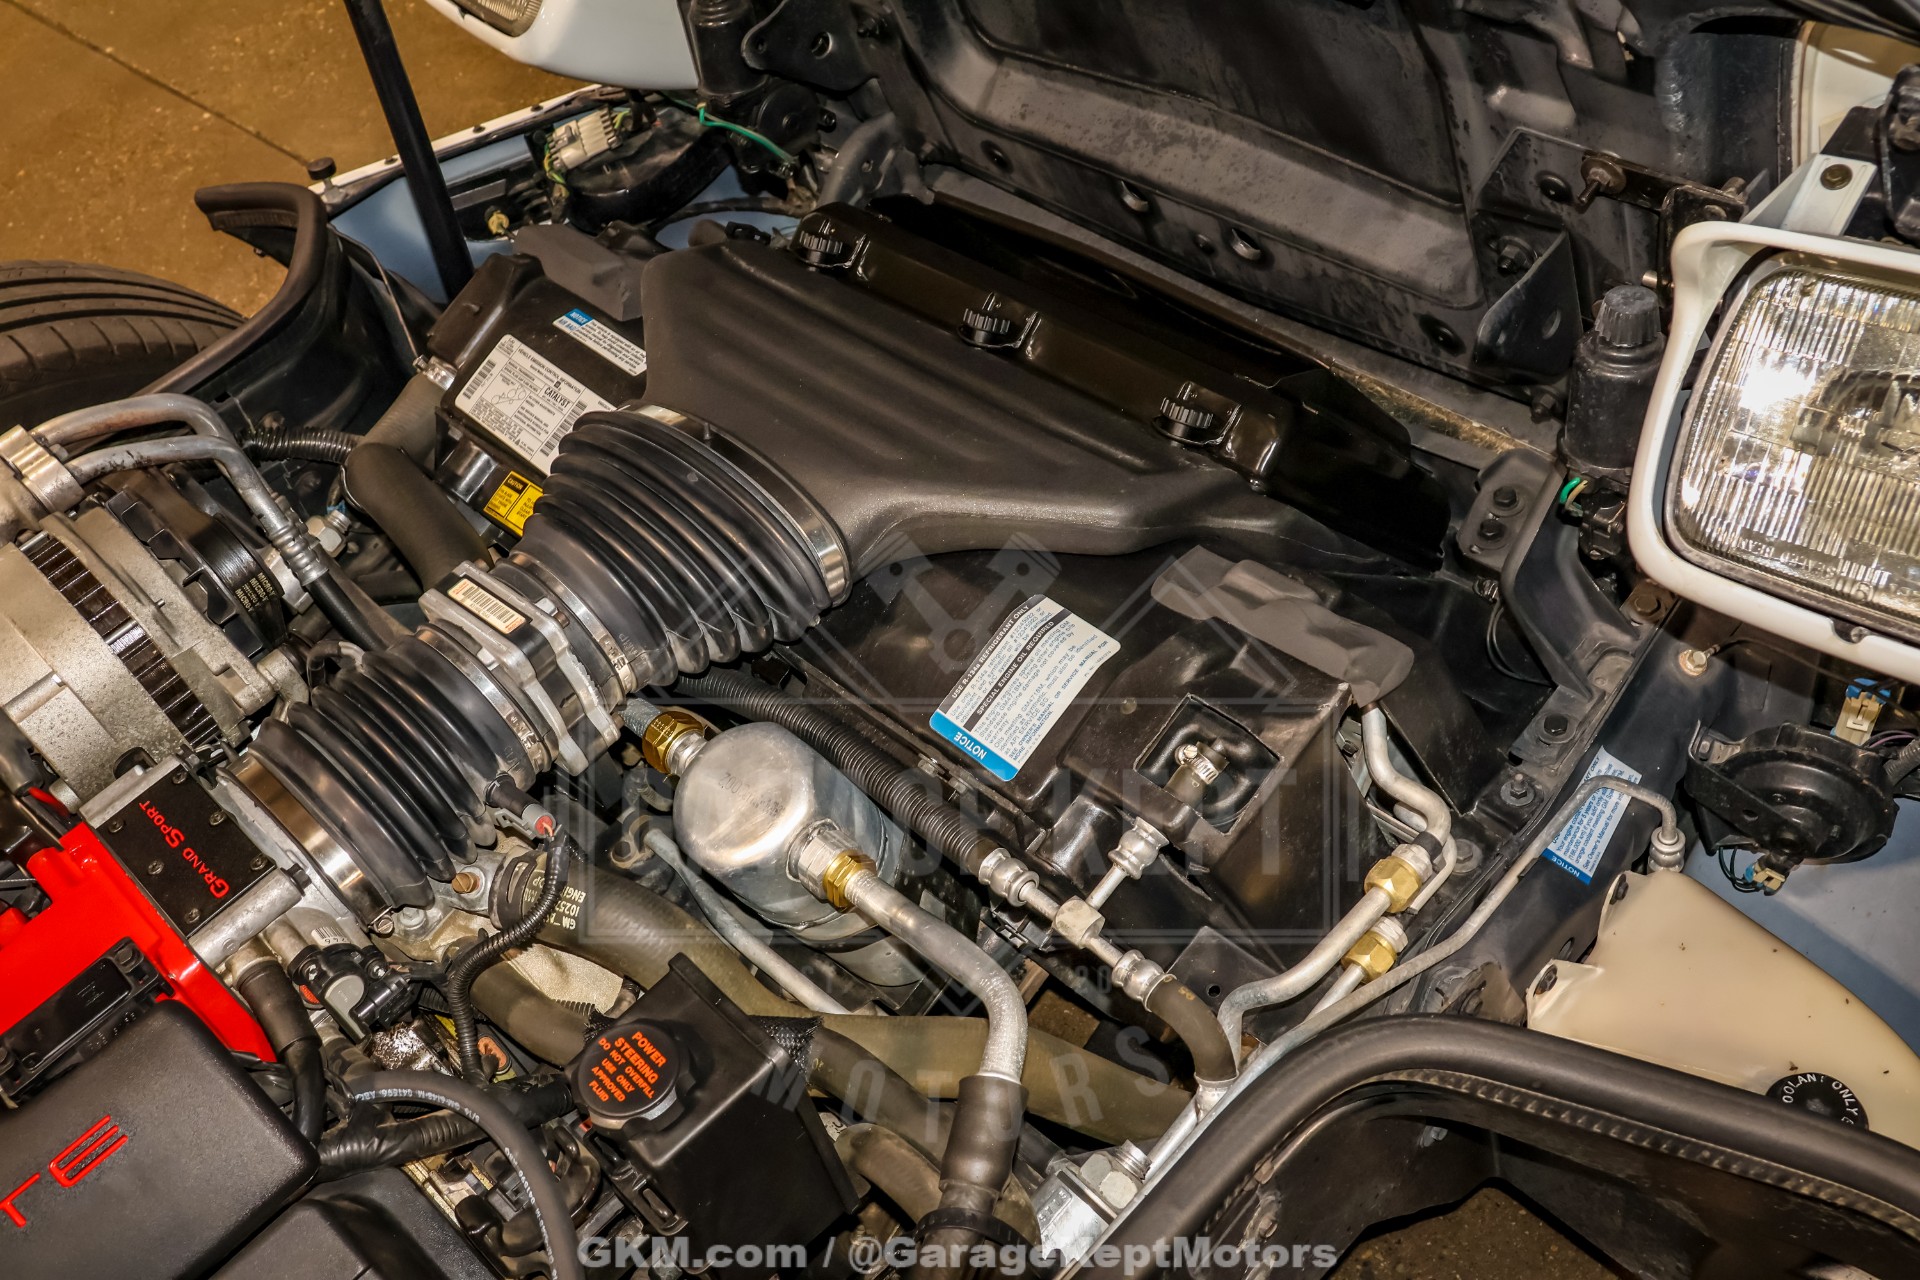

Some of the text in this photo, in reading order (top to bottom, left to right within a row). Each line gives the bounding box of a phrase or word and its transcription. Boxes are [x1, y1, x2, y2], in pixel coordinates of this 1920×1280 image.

[542, 385, 571, 408] CATALYST
[950, 602, 1030, 699] USE R-134a REFRIGERANT ONLY
[976, 686, 999, 715] SPECIAL
[997, 661, 1018, 687] ENGINE
[1016, 650, 1027, 663] OIL
[1025, 618, 1054, 652] REQUIRED
[952, 730, 987, 760] NOTICE
[1589, 756, 1600, 771] ONLY
[138, 798, 186, 850] SPORT
[1583, 800, 1595, 815] years
[1596, 820, 1610, 839] Manual
[1550, 855, 1580, 877] NOTICE
[597, 1036, 657, 1099] DO NOT OVERFILL
[611, 1035, 661, 1085] STEERING
[629, 1030, 668, 1068] POWER
[587, 1078, 611, 1102] FLUID
[588, 1064, 628, 1103] APPROVED
[599, 1057, 636, 1094] USE ONLY
[1782, 1073, 1858, 1115] OOLAN ONLY
